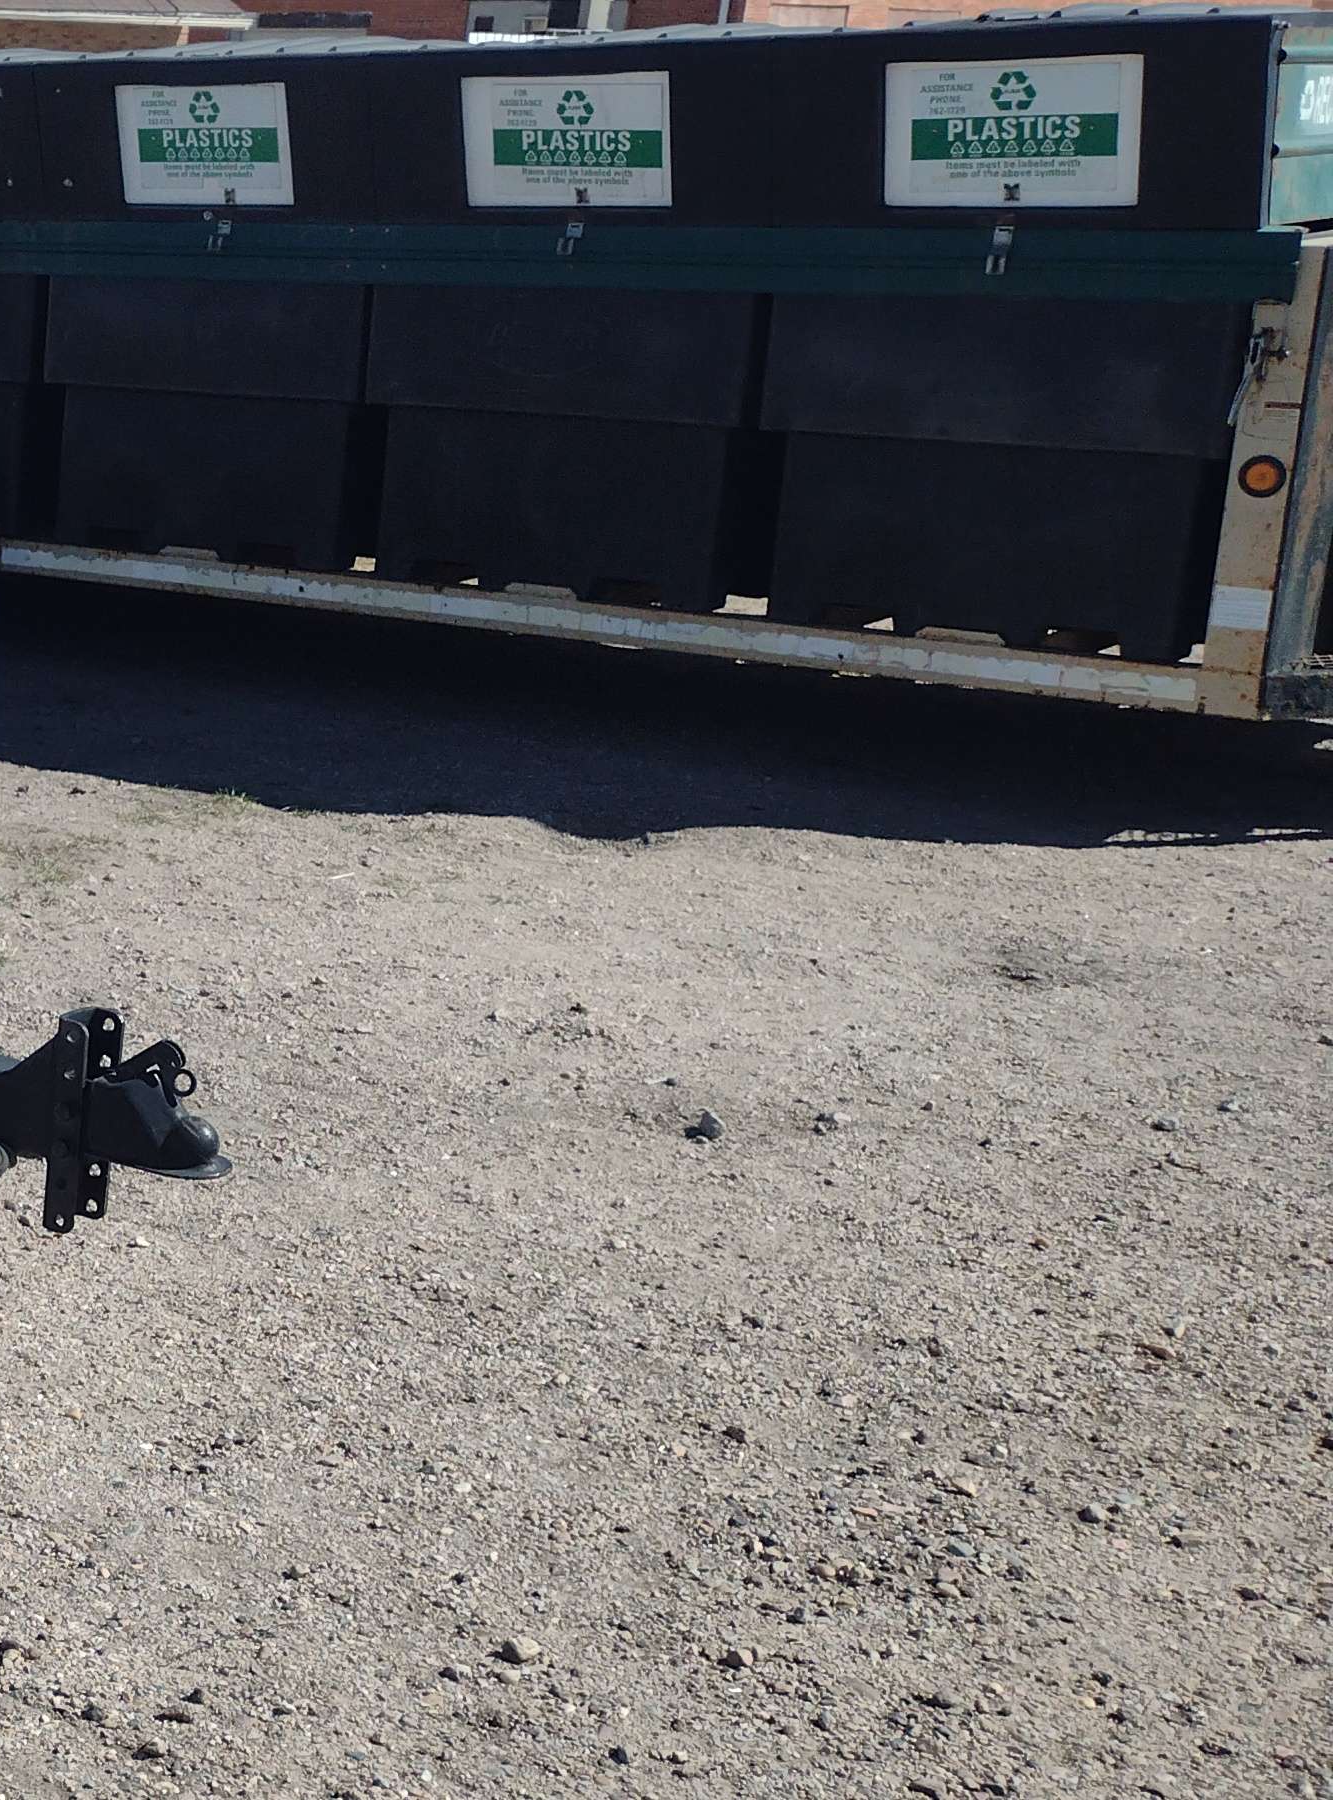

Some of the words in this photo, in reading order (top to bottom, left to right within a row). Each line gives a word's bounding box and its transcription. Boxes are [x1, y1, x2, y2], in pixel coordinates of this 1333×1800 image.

[920, 83, 974, 94] ASSISTANCE
[161, 128, 254, 148] PLASTICS
[946, 115, 1082, 142] PLASTICS
[521, 130, 632, 152] PLASTICS
